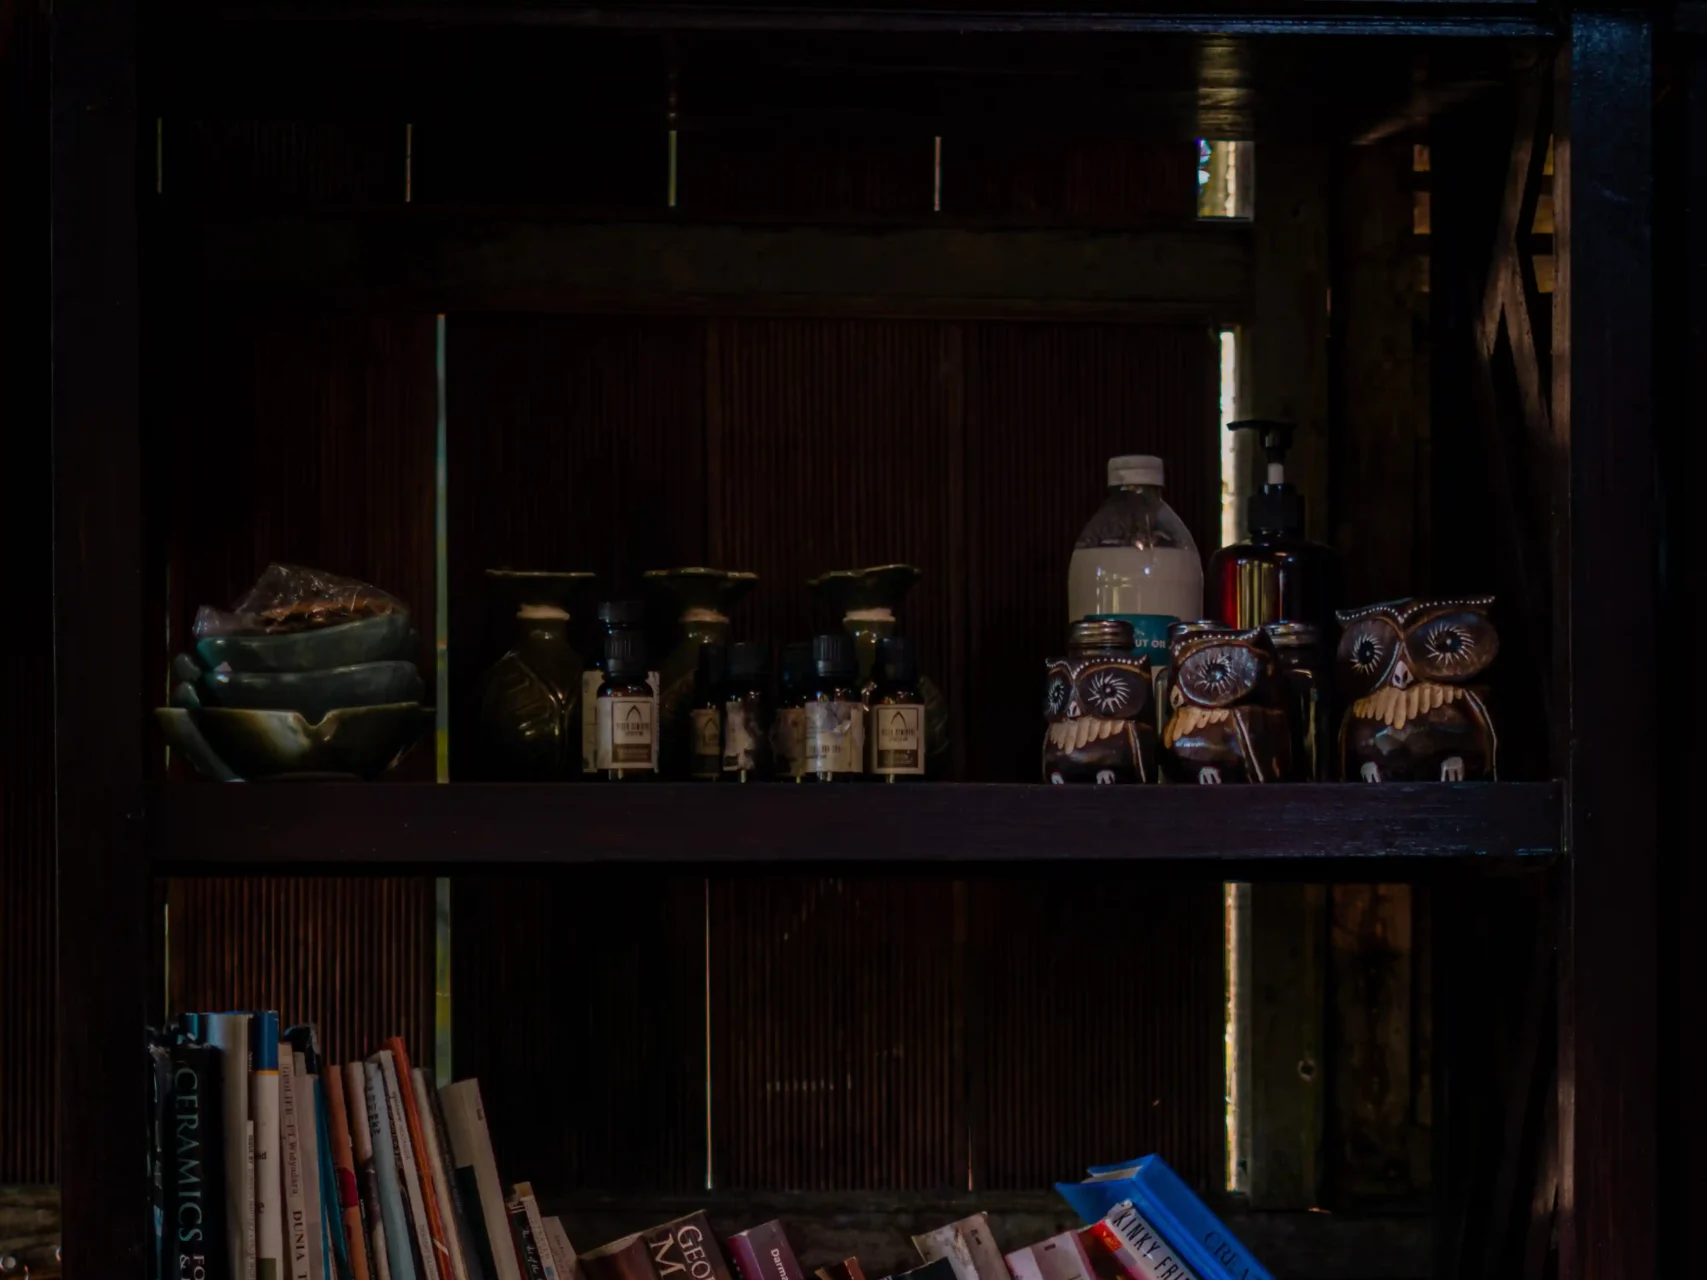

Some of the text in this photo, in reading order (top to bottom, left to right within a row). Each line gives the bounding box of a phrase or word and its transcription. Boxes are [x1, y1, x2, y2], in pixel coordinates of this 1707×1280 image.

[170, 1067, 205, 1243] CERAMICS
[179, 1254, 190, 1266] &
[292, 1210, 306, 1261] DUNIA
[1111, 1207, 1161, 1261] KINKY
